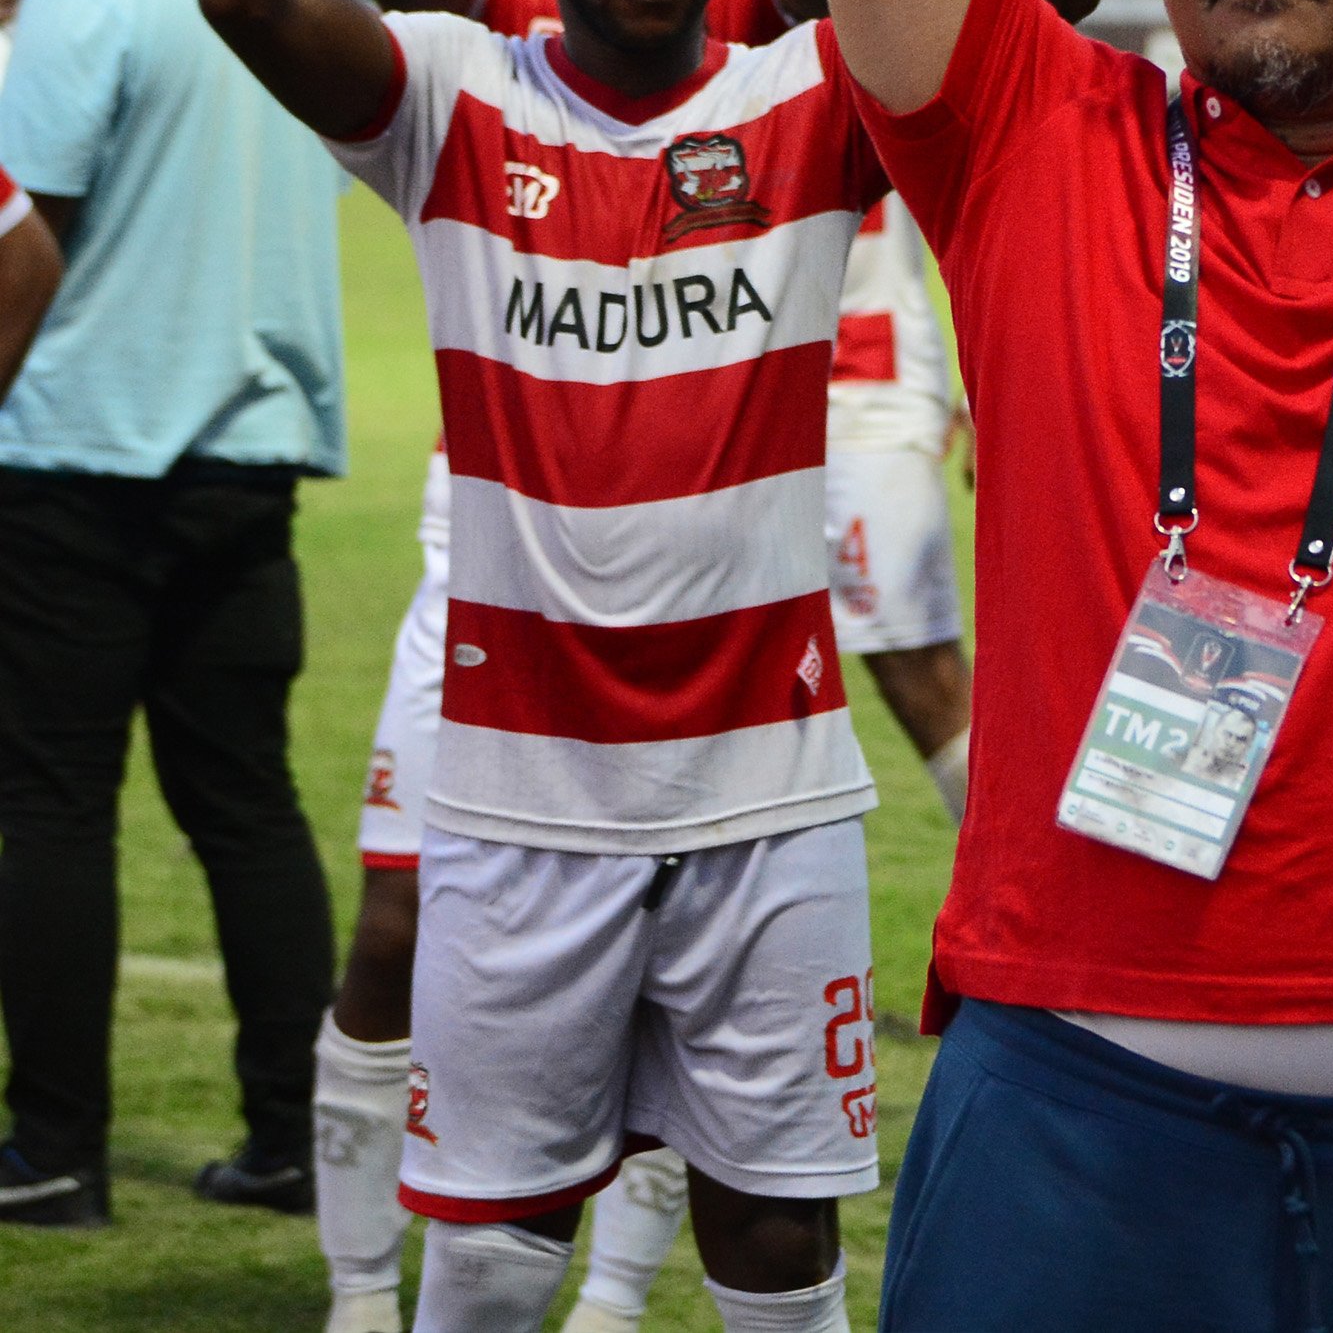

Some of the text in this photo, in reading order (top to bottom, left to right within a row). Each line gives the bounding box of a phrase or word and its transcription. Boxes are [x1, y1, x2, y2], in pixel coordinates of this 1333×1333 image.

[1171, 141, 1195, 236] PRESIDEN
[1169, 235, 1192, 284] 2019
[504, 267, 774, 354] MADURA
